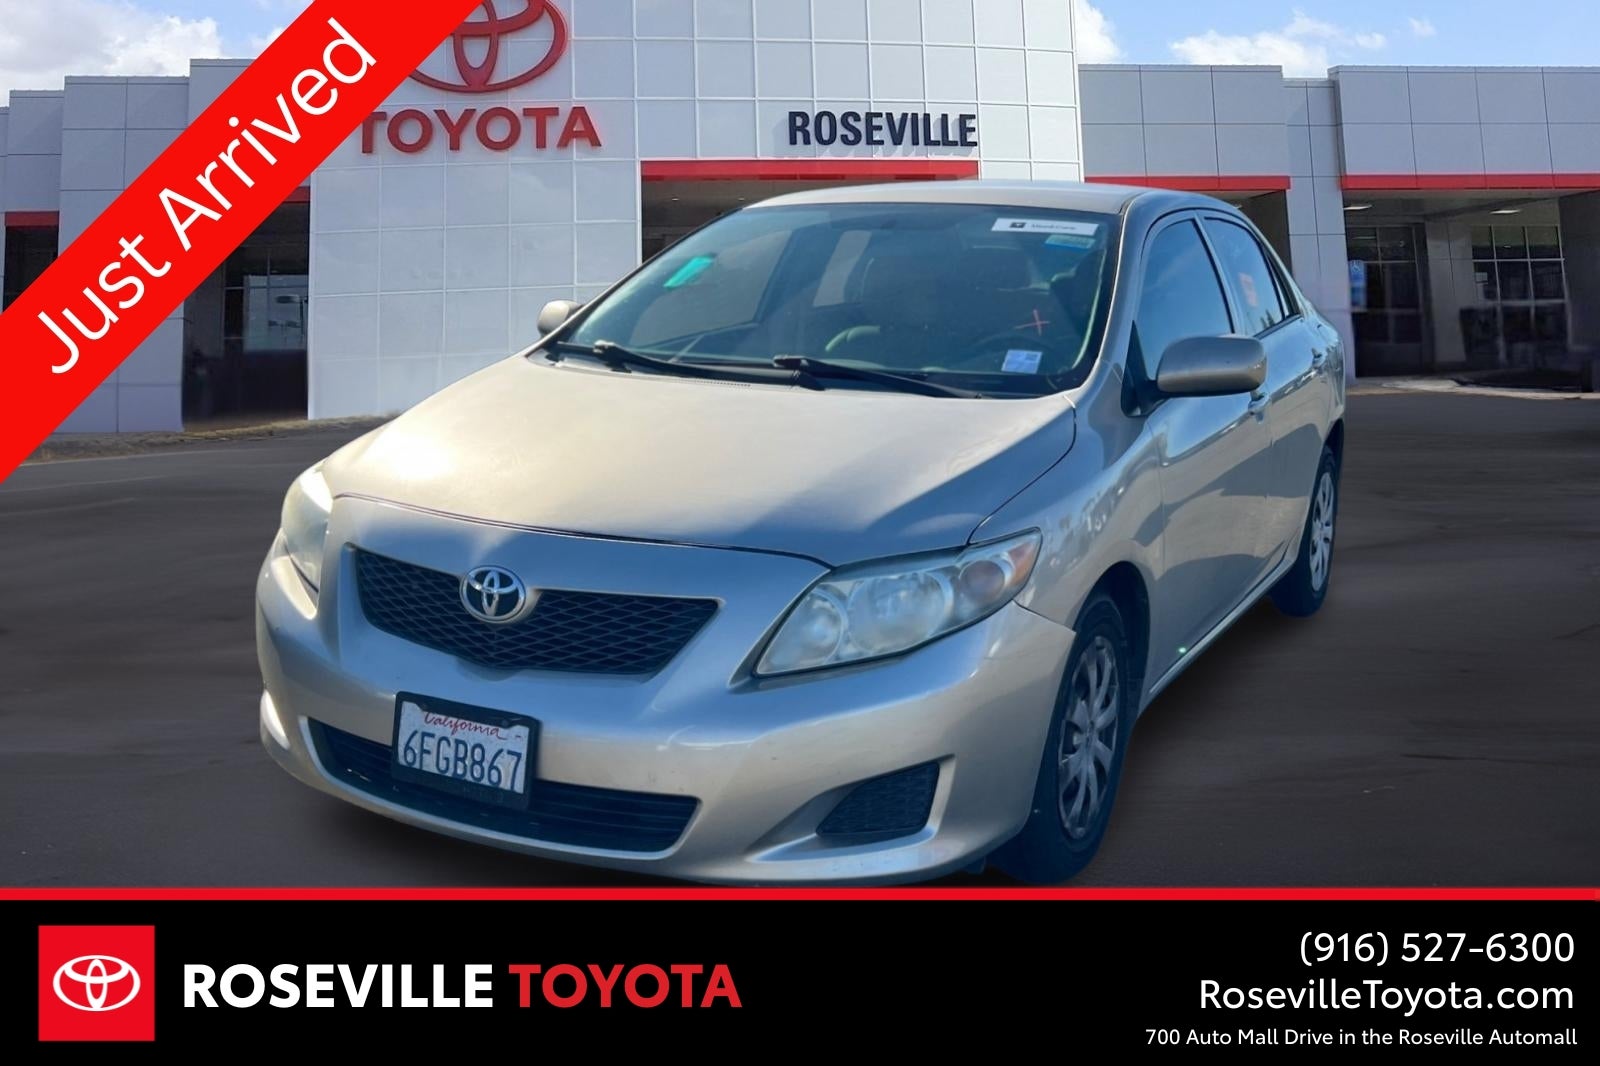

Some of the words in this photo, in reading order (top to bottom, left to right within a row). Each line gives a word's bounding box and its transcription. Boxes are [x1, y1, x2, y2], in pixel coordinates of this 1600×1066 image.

[361, 106, 602, 154] TOYOTA
[788, 110, 978, 147] ROSEVILLE
[424, 711, 508, 741] California
[403, 729, 522, 792] 6FGB867
